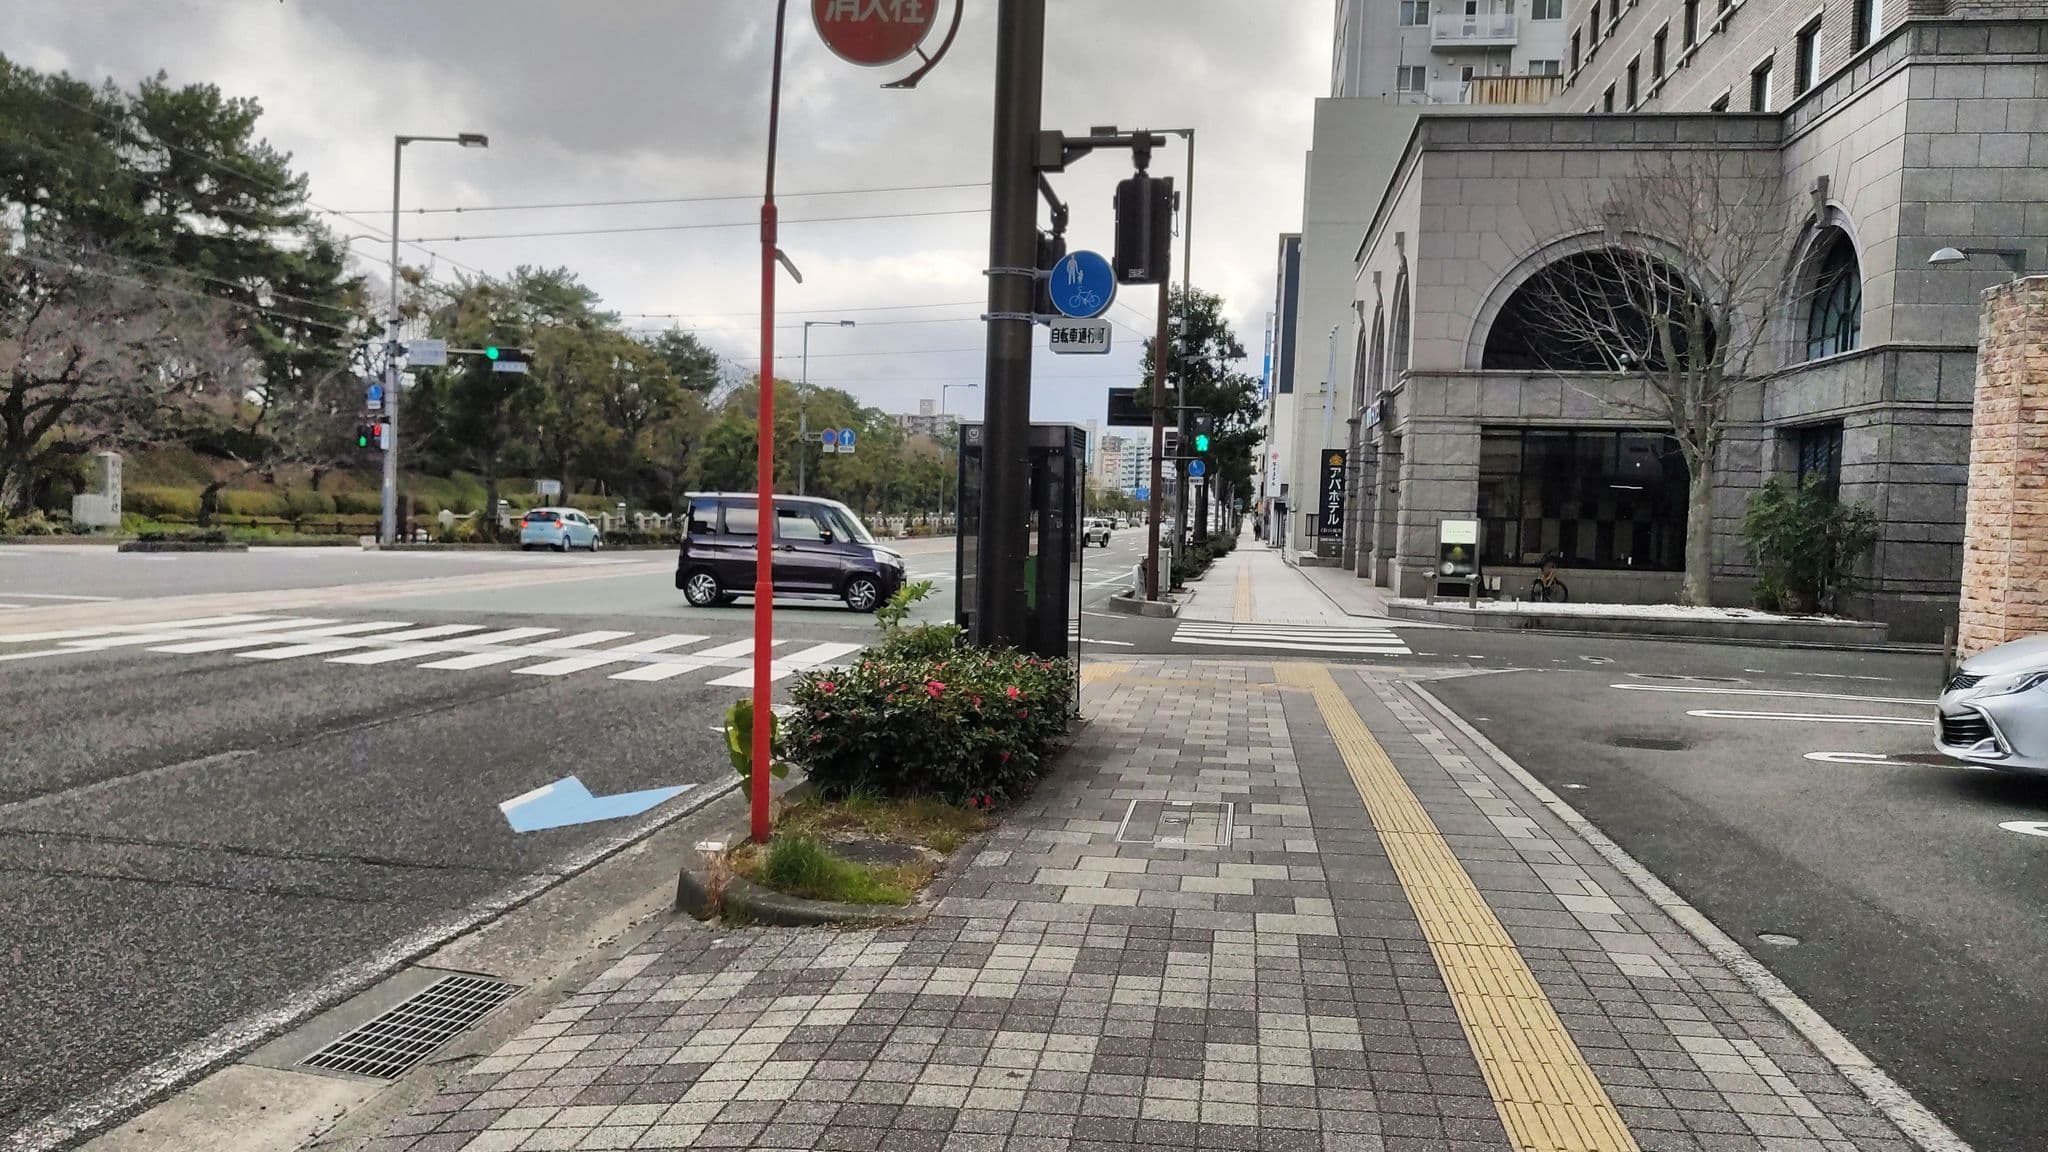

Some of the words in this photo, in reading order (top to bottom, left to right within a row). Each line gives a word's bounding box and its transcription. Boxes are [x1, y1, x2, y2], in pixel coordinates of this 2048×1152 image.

[1327, 467, 1342, 526] アパホテル
